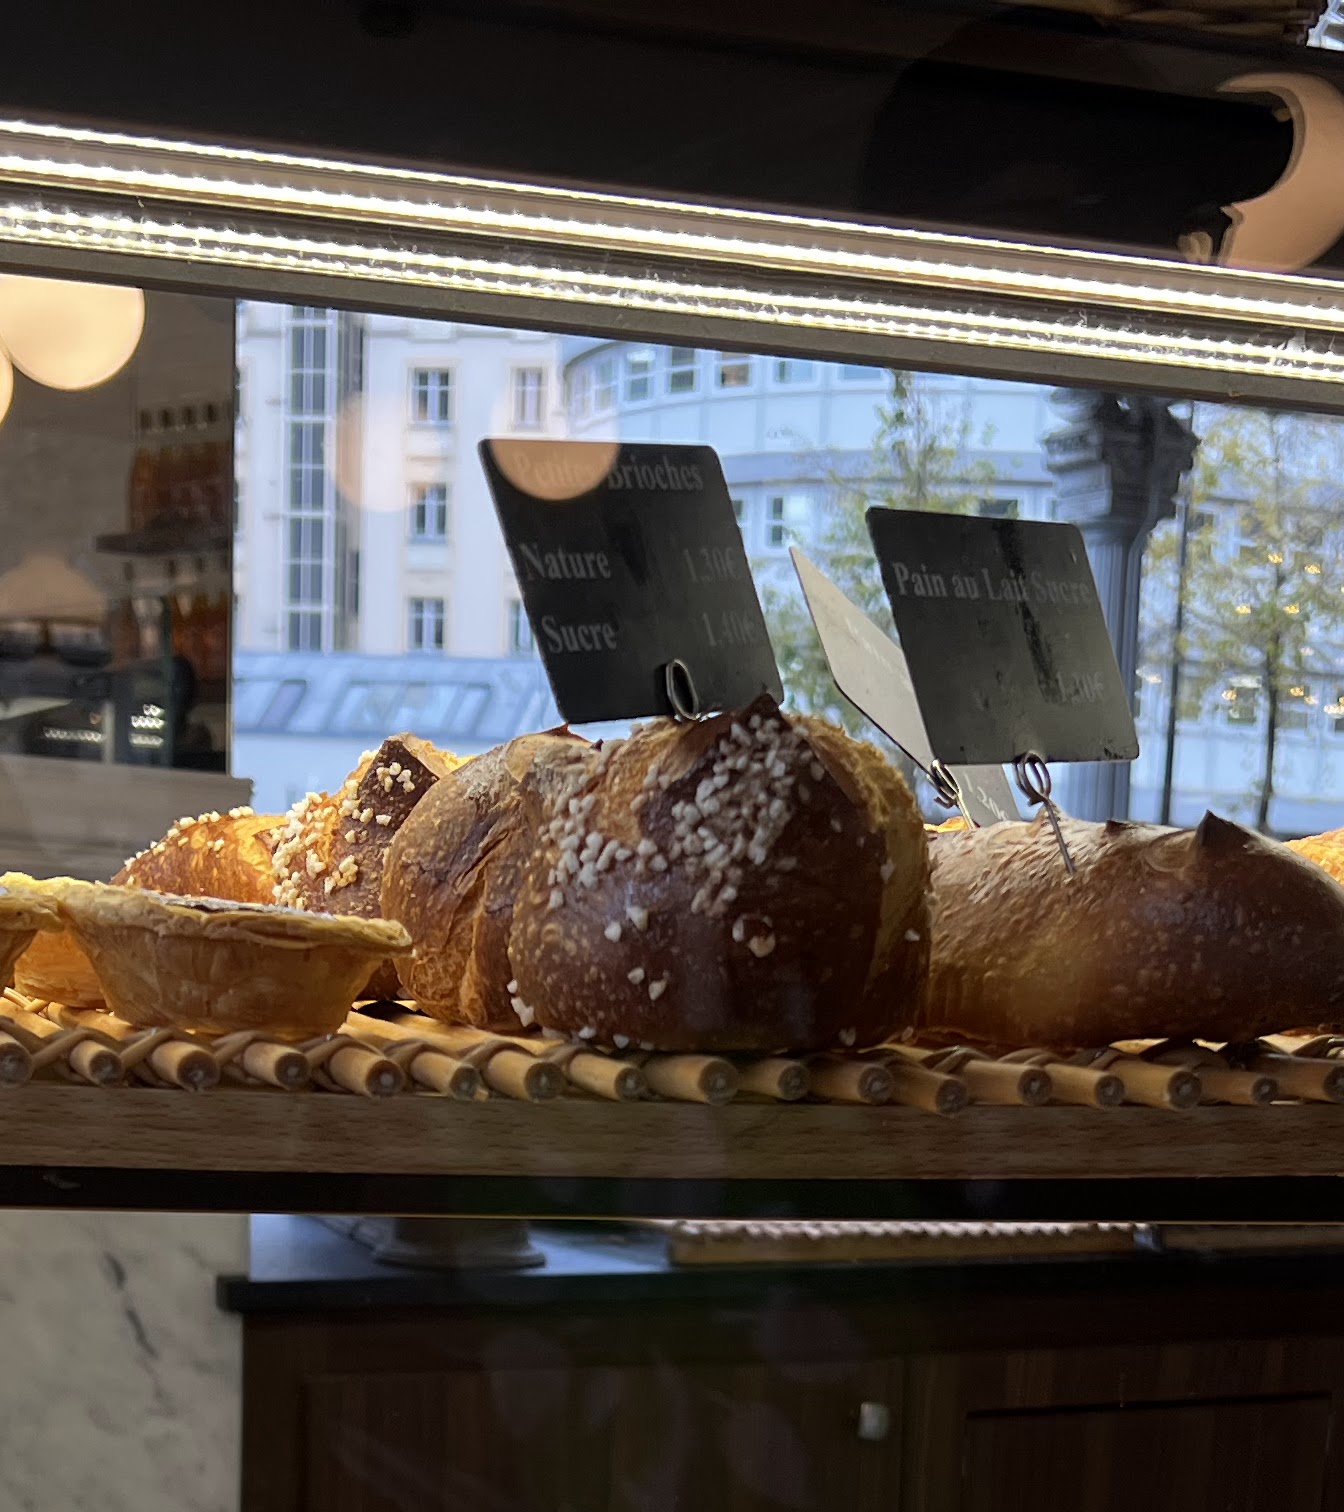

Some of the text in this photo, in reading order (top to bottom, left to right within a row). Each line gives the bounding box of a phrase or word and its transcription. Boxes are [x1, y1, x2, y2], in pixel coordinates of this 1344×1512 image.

[518, 542, 612, 580] Nature
[891, 561, 947, 596] Pain
[952, 574, 979, 600] au
[540, 614, 618, 654] Sucre
